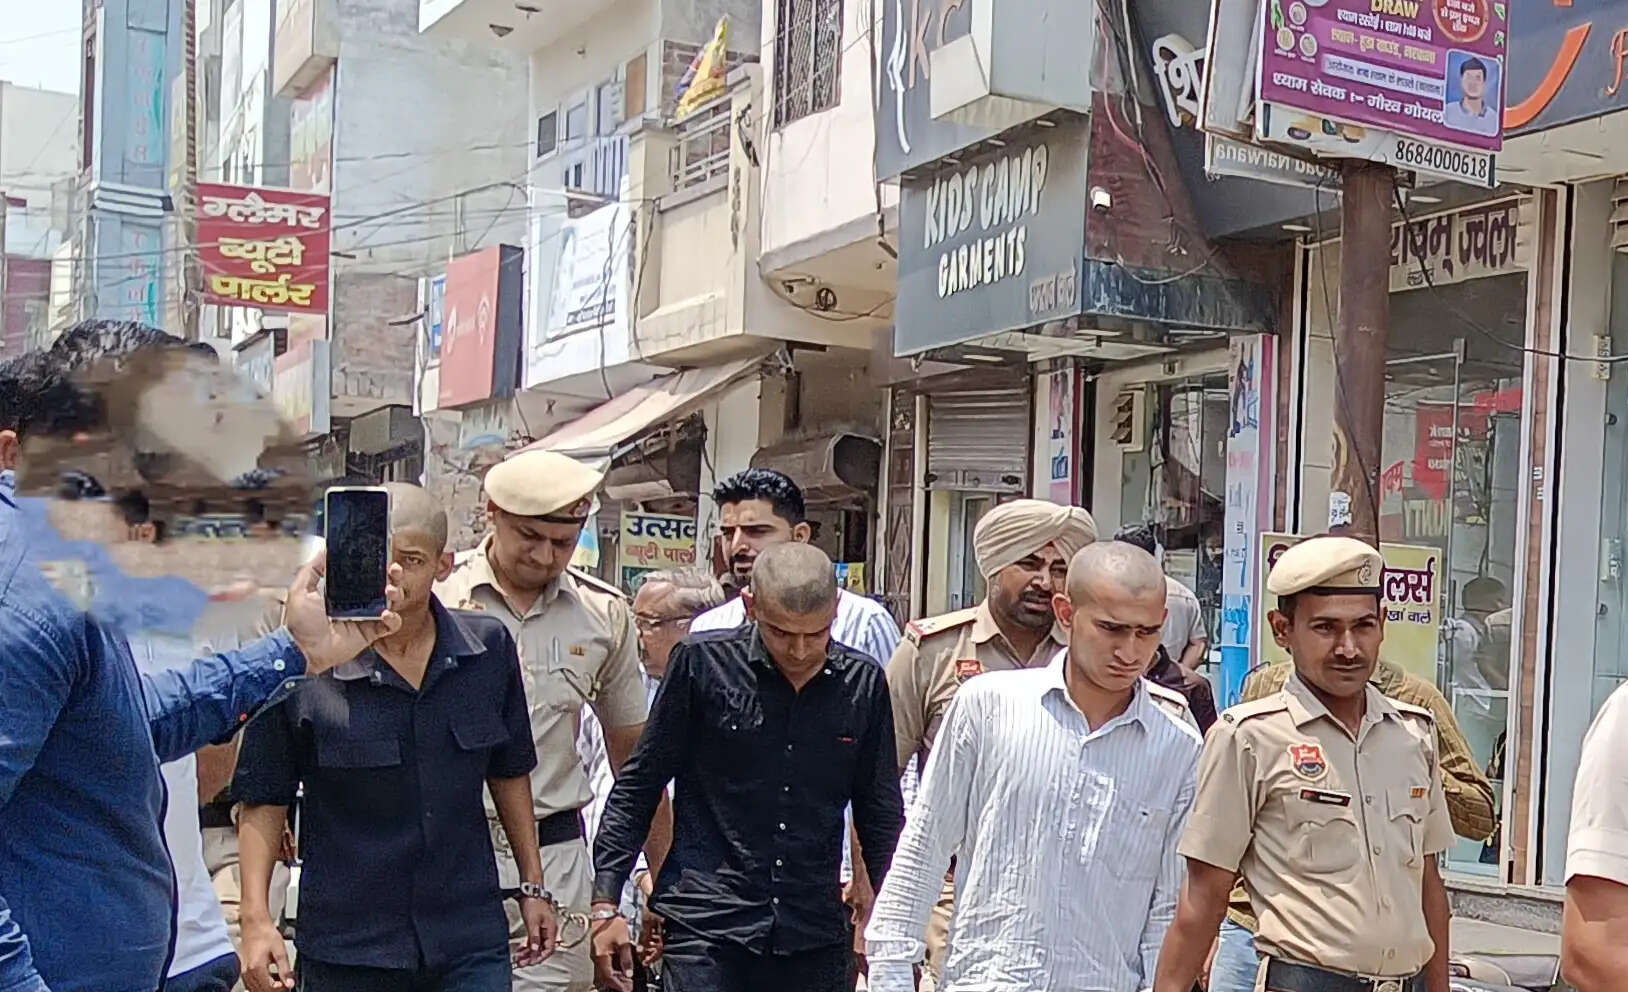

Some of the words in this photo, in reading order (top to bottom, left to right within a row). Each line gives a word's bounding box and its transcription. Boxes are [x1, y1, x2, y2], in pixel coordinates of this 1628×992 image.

[1371, 0, 1418, 19] DRAW
[1273, 72, 1307, 91] श्याम
[1310, 78, 1347, 100] सेवक
[1404, 102, 1444, 123] गोयल
[1395, 140, 1486, 178] 8684000618
[202, 191, 325, 228] ग्लैमर
[924, 164, 978, 248] KIDS
[980, 143, 1048, 231] CAMP
[218, 236, 305, 273] ब्यूटी
[938, 224, 1026, 298] GARMENTS
[211, 273, 315, 306] पार्लर
[664, 544, 697, 563] पार्ल
